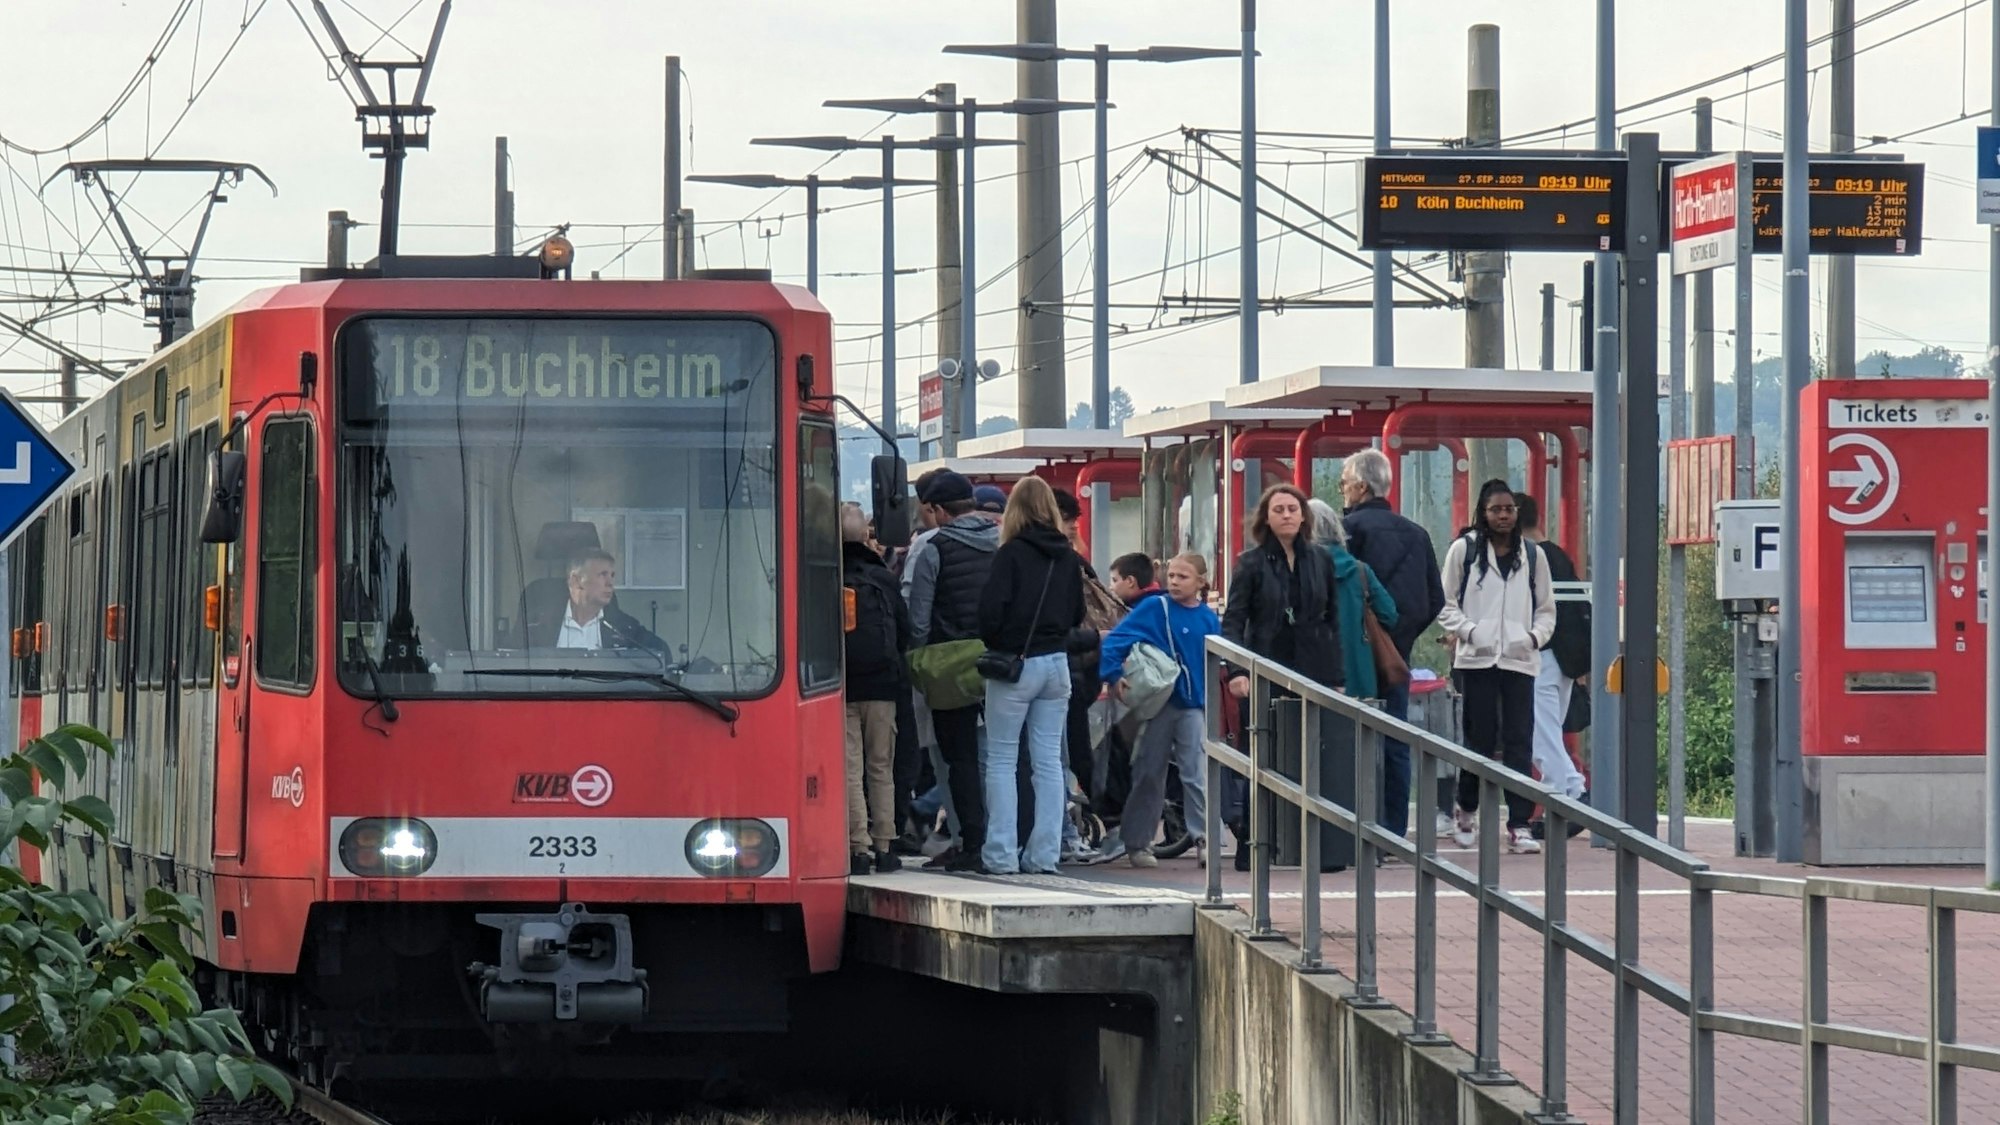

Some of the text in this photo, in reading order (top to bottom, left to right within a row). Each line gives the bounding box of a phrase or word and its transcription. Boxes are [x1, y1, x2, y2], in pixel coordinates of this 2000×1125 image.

[1381, 174, 1612, 189] MITTWOCH 27.SEP.2023 09:19 Uhr
[1835, 179, 1873, 192] 09:19
[1881, 180, 1907, 192] Uhr
[1417, 195, 1449, 209] Köln
[1455, 196, 1525, 210] Buchheim
[1874, 195, 1906, 205] 2 min
[1867, 206, 1906, 216] 13 min
[1866, 216, 1906, 226] 22 min
[1837, 226, 1901, 237] Haltepunkt
[390, 335, 721, 398] 18 Buchheim
[1844, 403, 1918, 422] Tickets
[1755, 526, 1780, 569] F
[272, 775, 291, 798] KVB
[517, 774, 571, 797] KVB
[529, 836, 597, 857] 2333
[559, 862, 565, 873] 2
